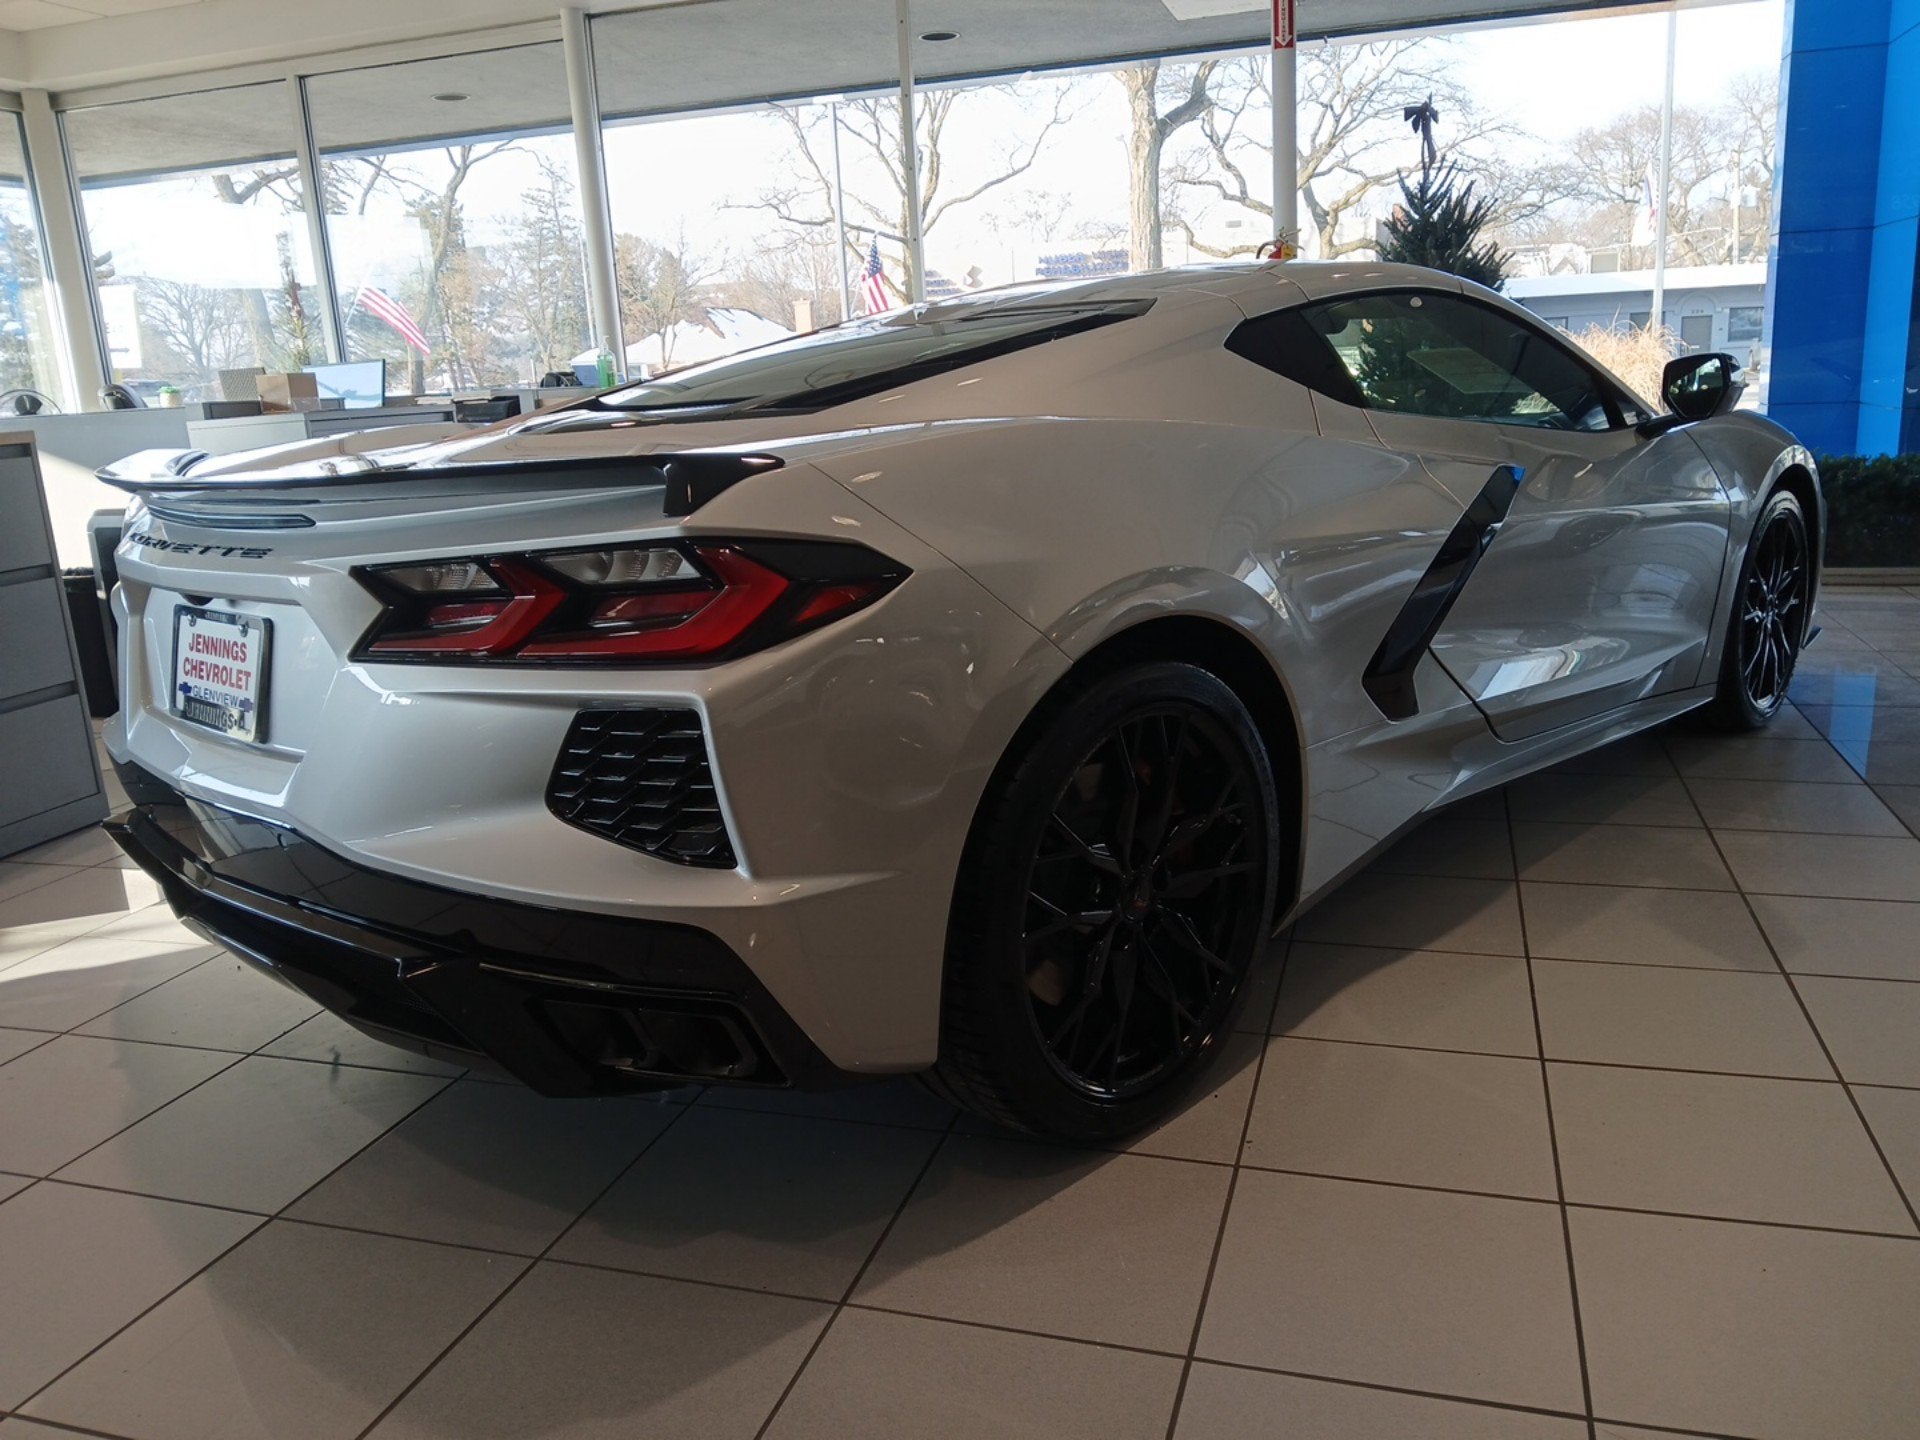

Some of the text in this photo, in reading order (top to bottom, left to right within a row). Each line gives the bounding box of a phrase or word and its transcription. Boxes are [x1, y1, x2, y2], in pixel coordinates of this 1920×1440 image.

[129, 532, 273, 559] CORVETTE
[188, 633, 247, 664] JENNINGS
[183, 658, 251, 691] CHEVROLET
[192, 685, 240, 707] GLENVIEW
